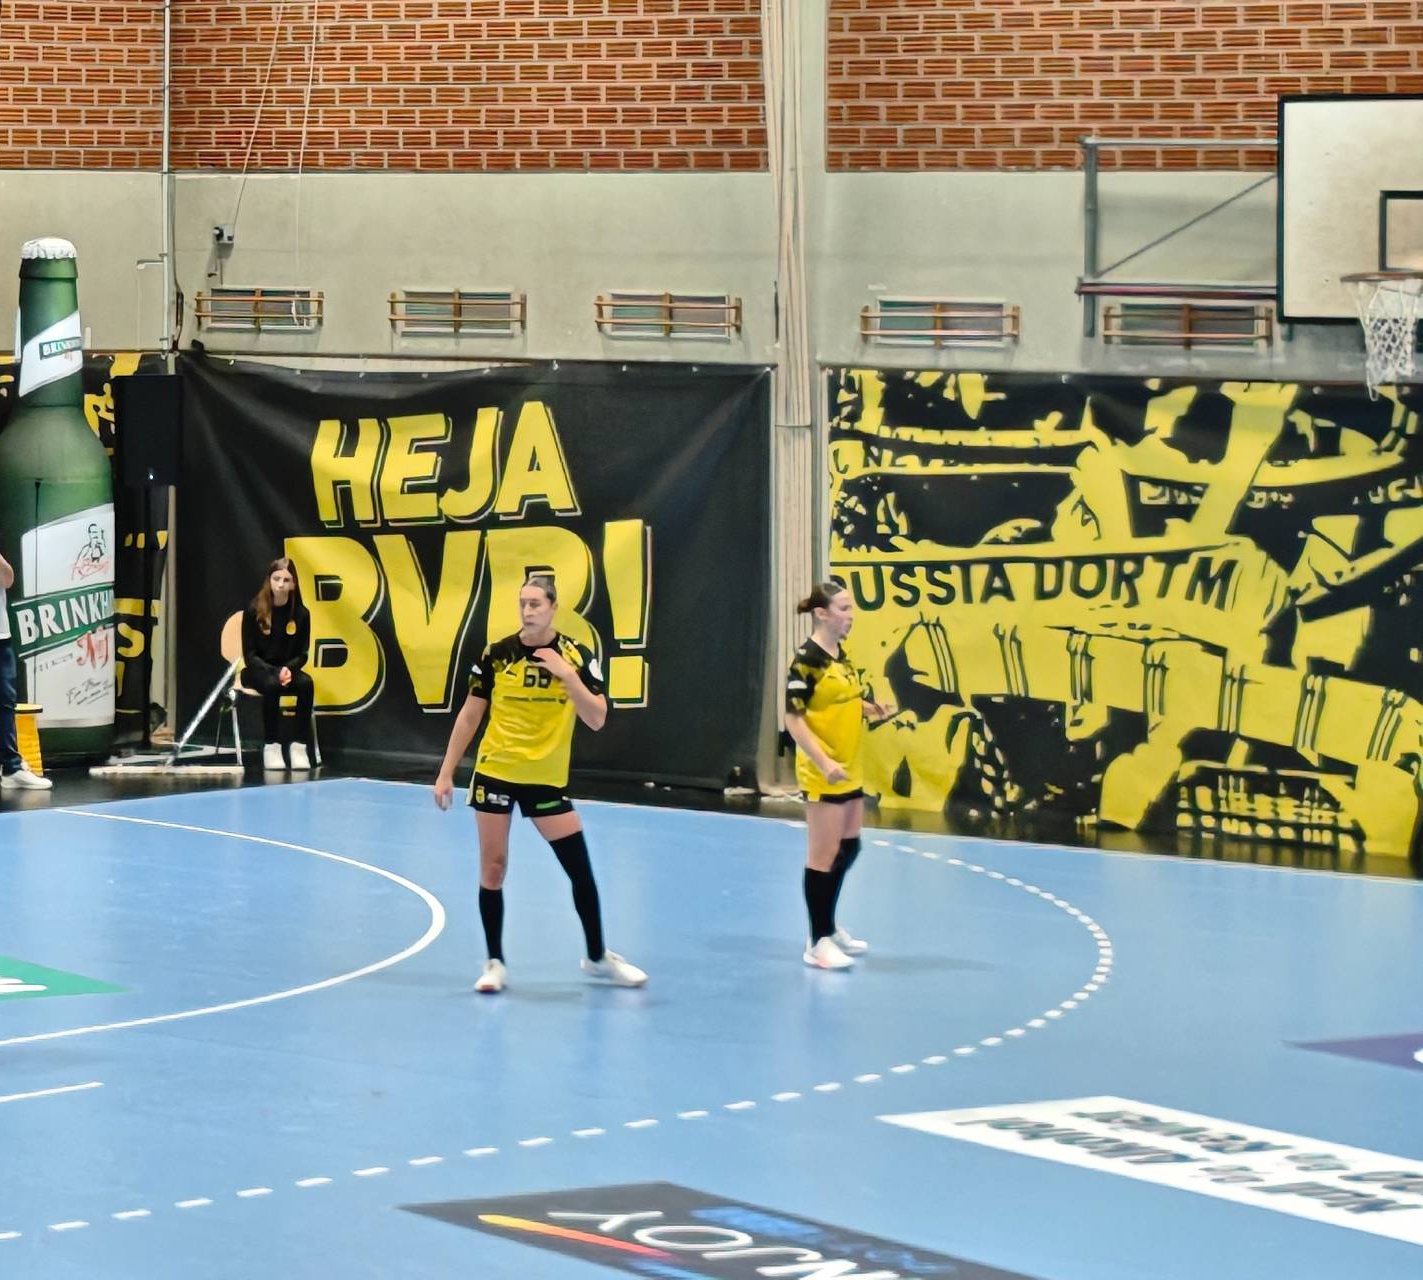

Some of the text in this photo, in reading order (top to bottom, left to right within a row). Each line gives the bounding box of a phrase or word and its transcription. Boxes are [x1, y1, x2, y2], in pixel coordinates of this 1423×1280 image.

[311, 400, 581, 527] HEJA
[284, 517, 652, 715] BVB!
[953, 1116, 1211, 1165] Alkohol
